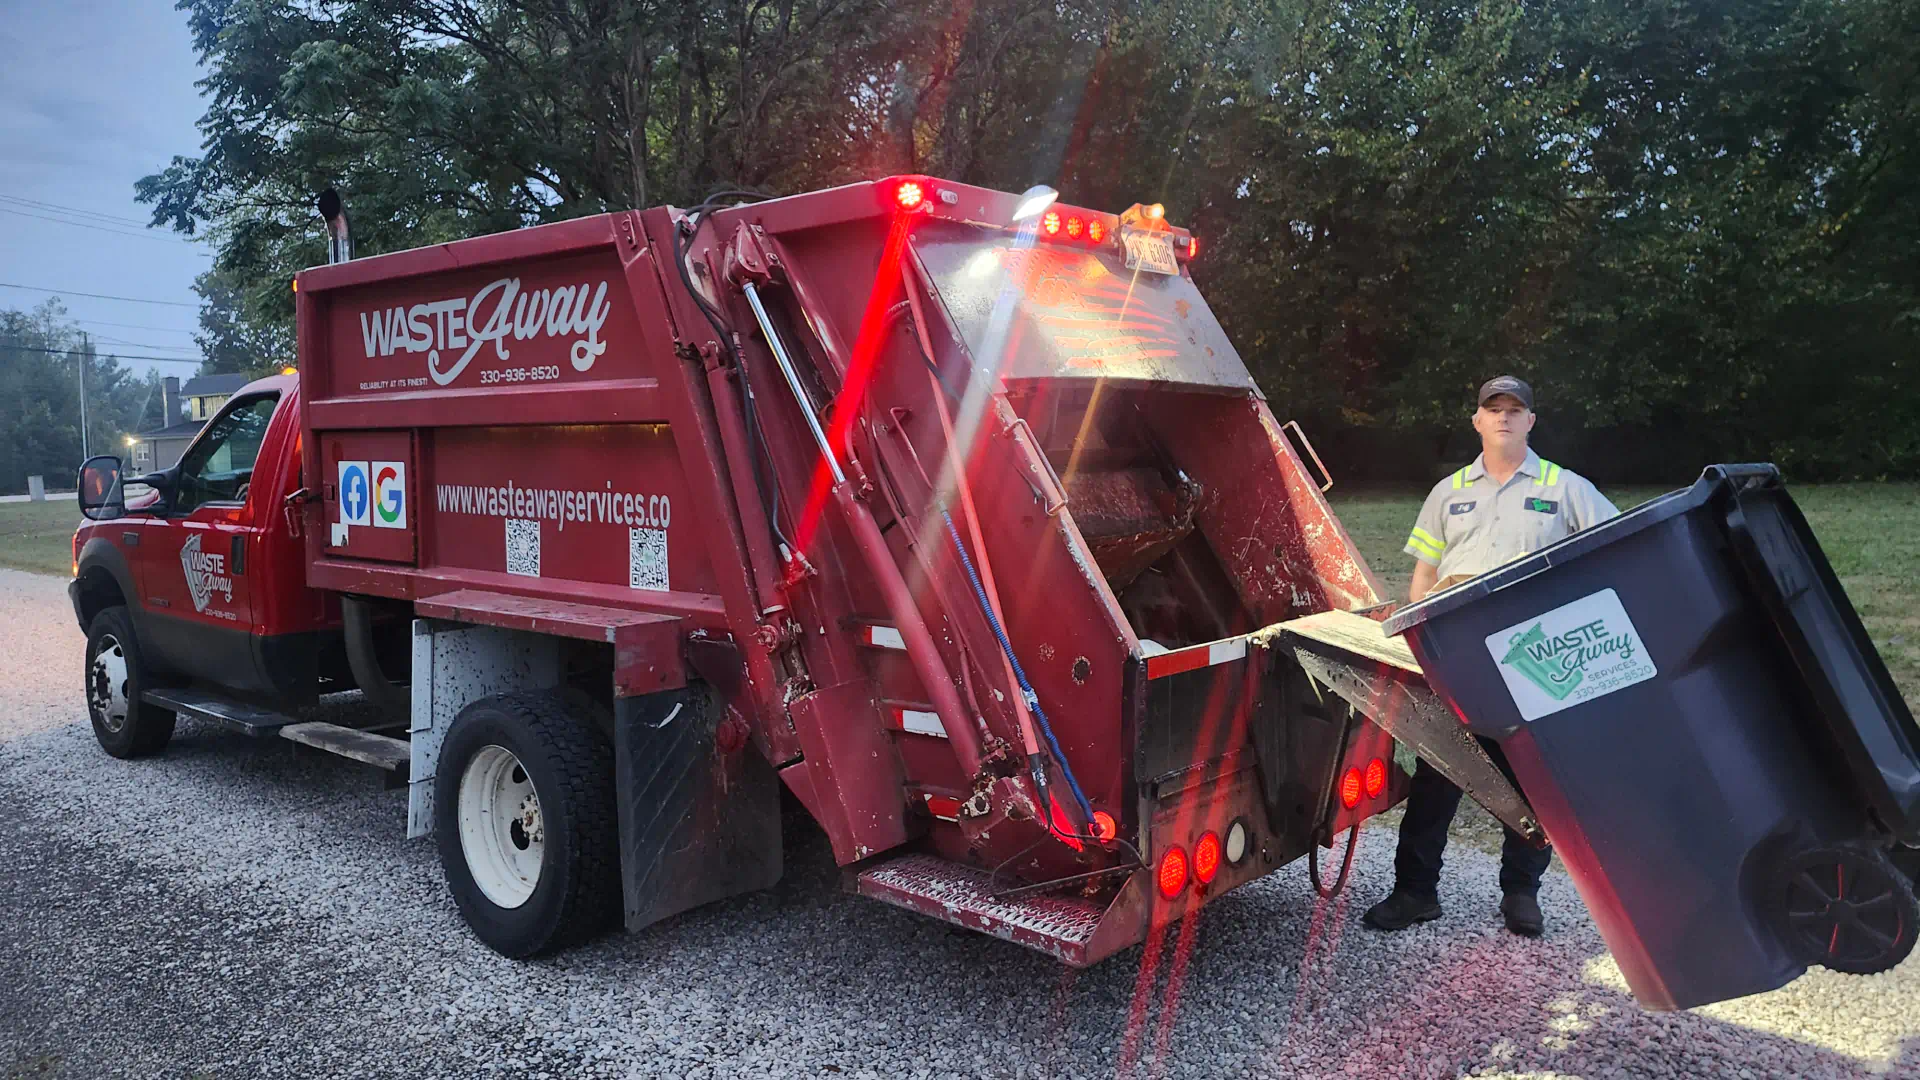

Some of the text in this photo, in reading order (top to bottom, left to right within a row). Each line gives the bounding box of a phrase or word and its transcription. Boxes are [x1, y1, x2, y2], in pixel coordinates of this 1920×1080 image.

[1148, 242, 1173, 265] 6306
[360, 277, 611, 385] WASTE Away
[360, 380, 389, 390] RELIABILITY
[390, 379, 397, 387] AT
[407, 377, 428, 386] FINEST!
[480, 365, 560, 384] 330-936-8520
[375, 466, 403, 523] G
[436, 479, 671, 532] www.wasteawayservices.co
[190, 550, 225, 574] WASTE
[196, 572, 232, 603] Away
[1526, 619, 1610, 662] WASTE
[1550, 632, 1636, 683] Away
[1587, 658, 1638, 682] SERVICES
[1574, 665, 1653, 700] 330-936-8520
